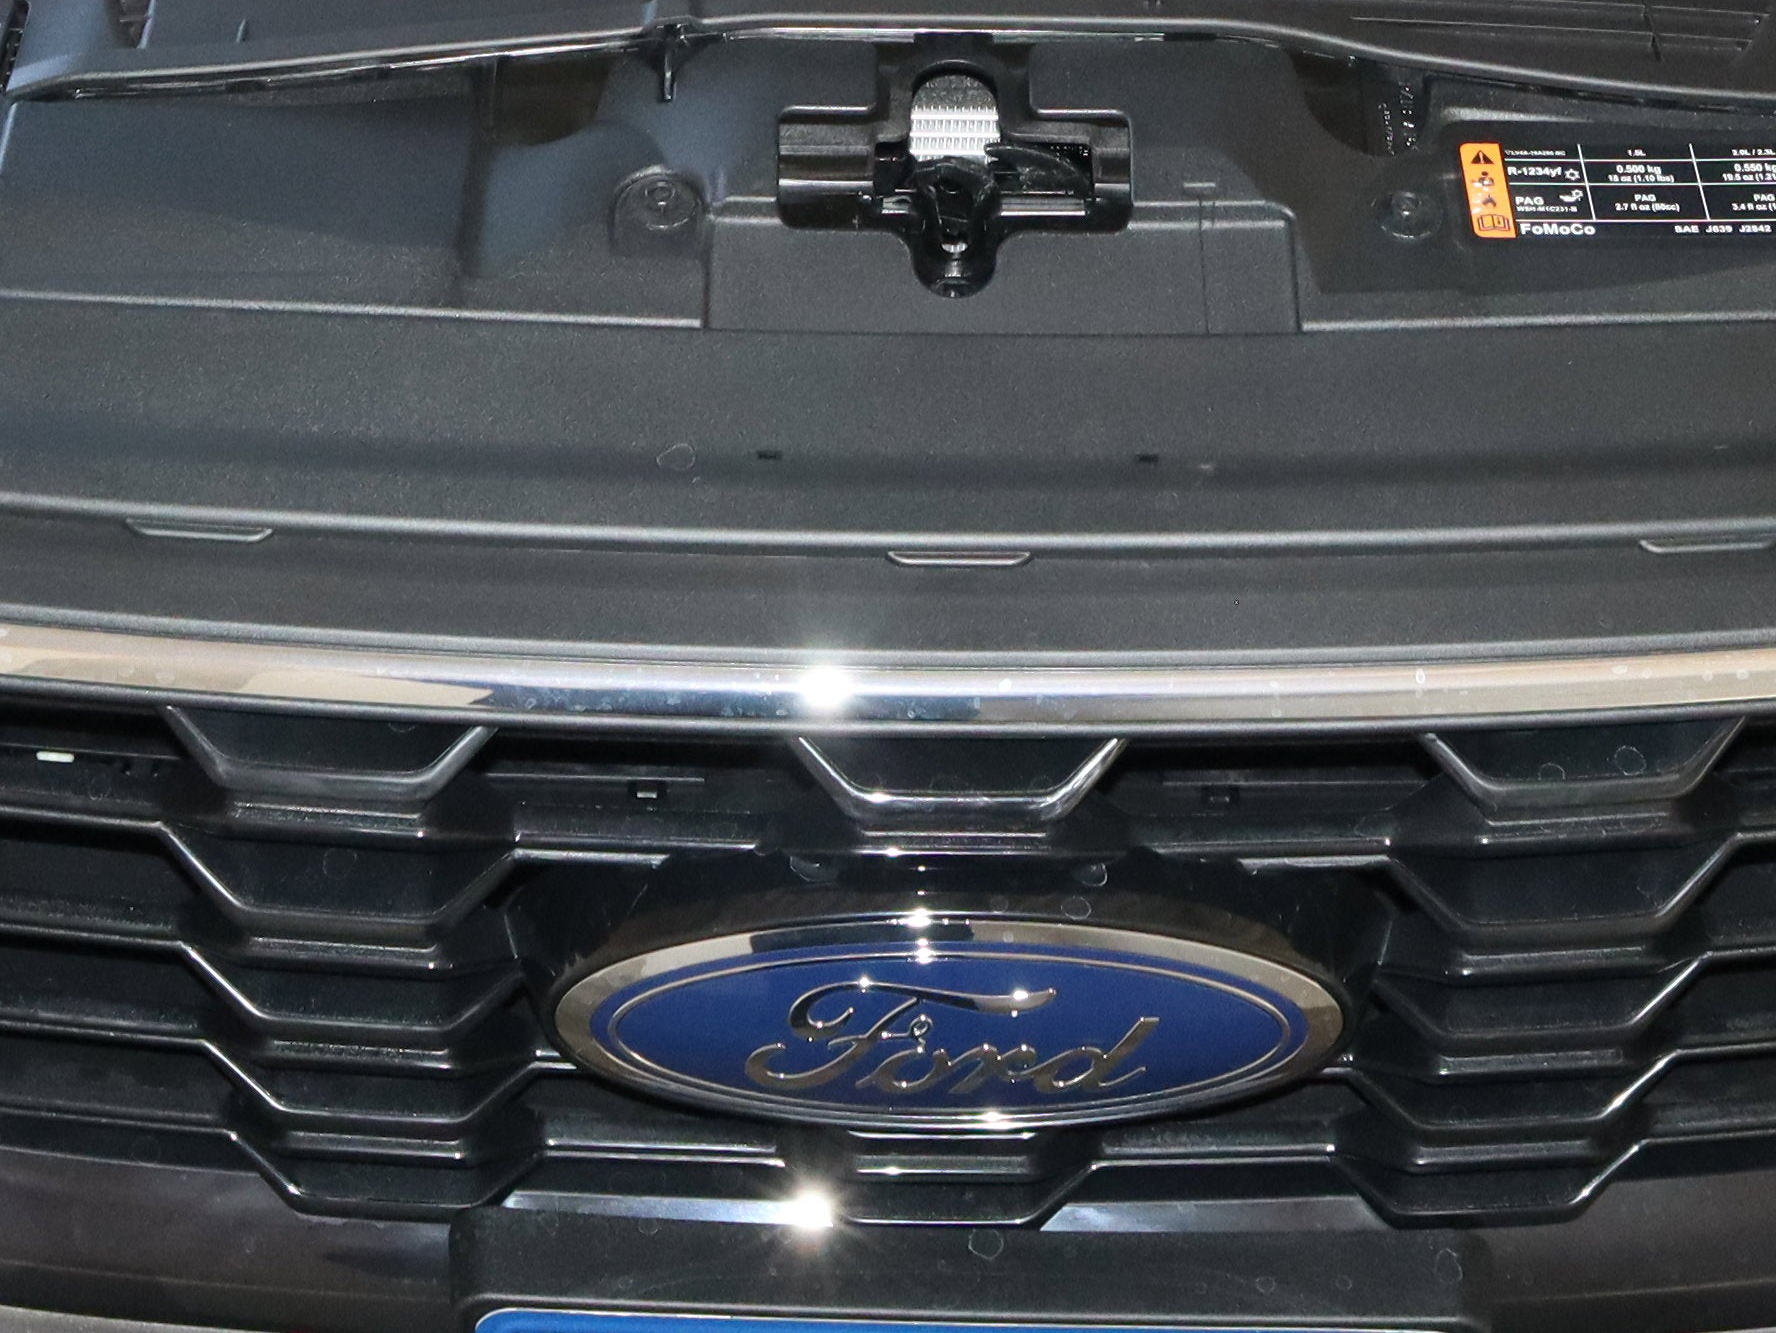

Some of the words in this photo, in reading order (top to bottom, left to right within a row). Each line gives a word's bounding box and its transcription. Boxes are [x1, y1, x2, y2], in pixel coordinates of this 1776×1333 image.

[1507, 166, 1562, 178] R-1234yf
[1616, 164, 1645, 173] 0.500
[1646, 164, 1662, 175] kg
[1734, 163, 1763, 172] 0.550
[1515, 196, 1544, 206] PAG
[1634, 194, 1657, 202] PAG
[1753, 193, 1776, 202] PAG
[1520, 223, 1596, 236] FoMoCo
[1674, 225, 1700, 234] SAE
[745, 978, 1160, 1096] Ford
